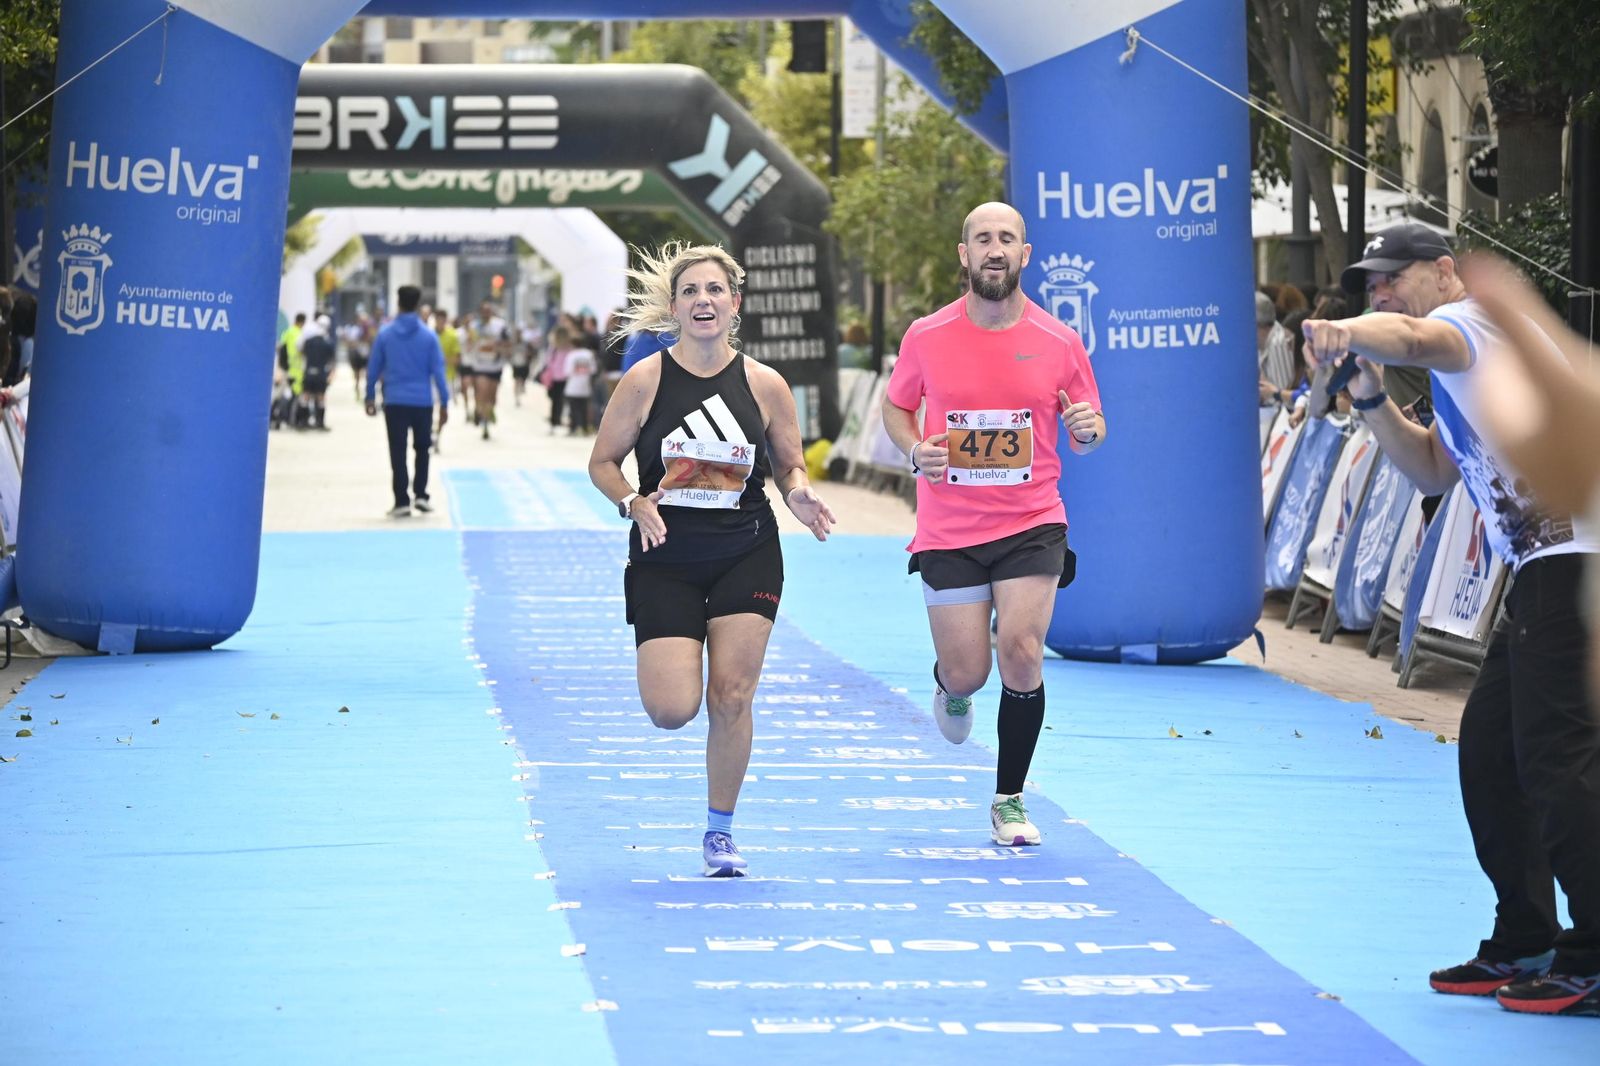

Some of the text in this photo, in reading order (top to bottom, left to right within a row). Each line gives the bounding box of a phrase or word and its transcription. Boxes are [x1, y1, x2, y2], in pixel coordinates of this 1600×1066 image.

[177, 204, 241, 225] original
[1157, 219, 1218, 242] original
[118, 283, 233, 304] Ayuntamiento de
[116, 301, 231, 332] HUELVA
[1108, 303, 1220, 325] Ayuntamiento de
[1108, 322, 1221, 350] HUELVA
[959, 430, 1020, 458] 473
[970, 470, 1007, 479] Huelva
[680, 489, 719, 501] Huelva
